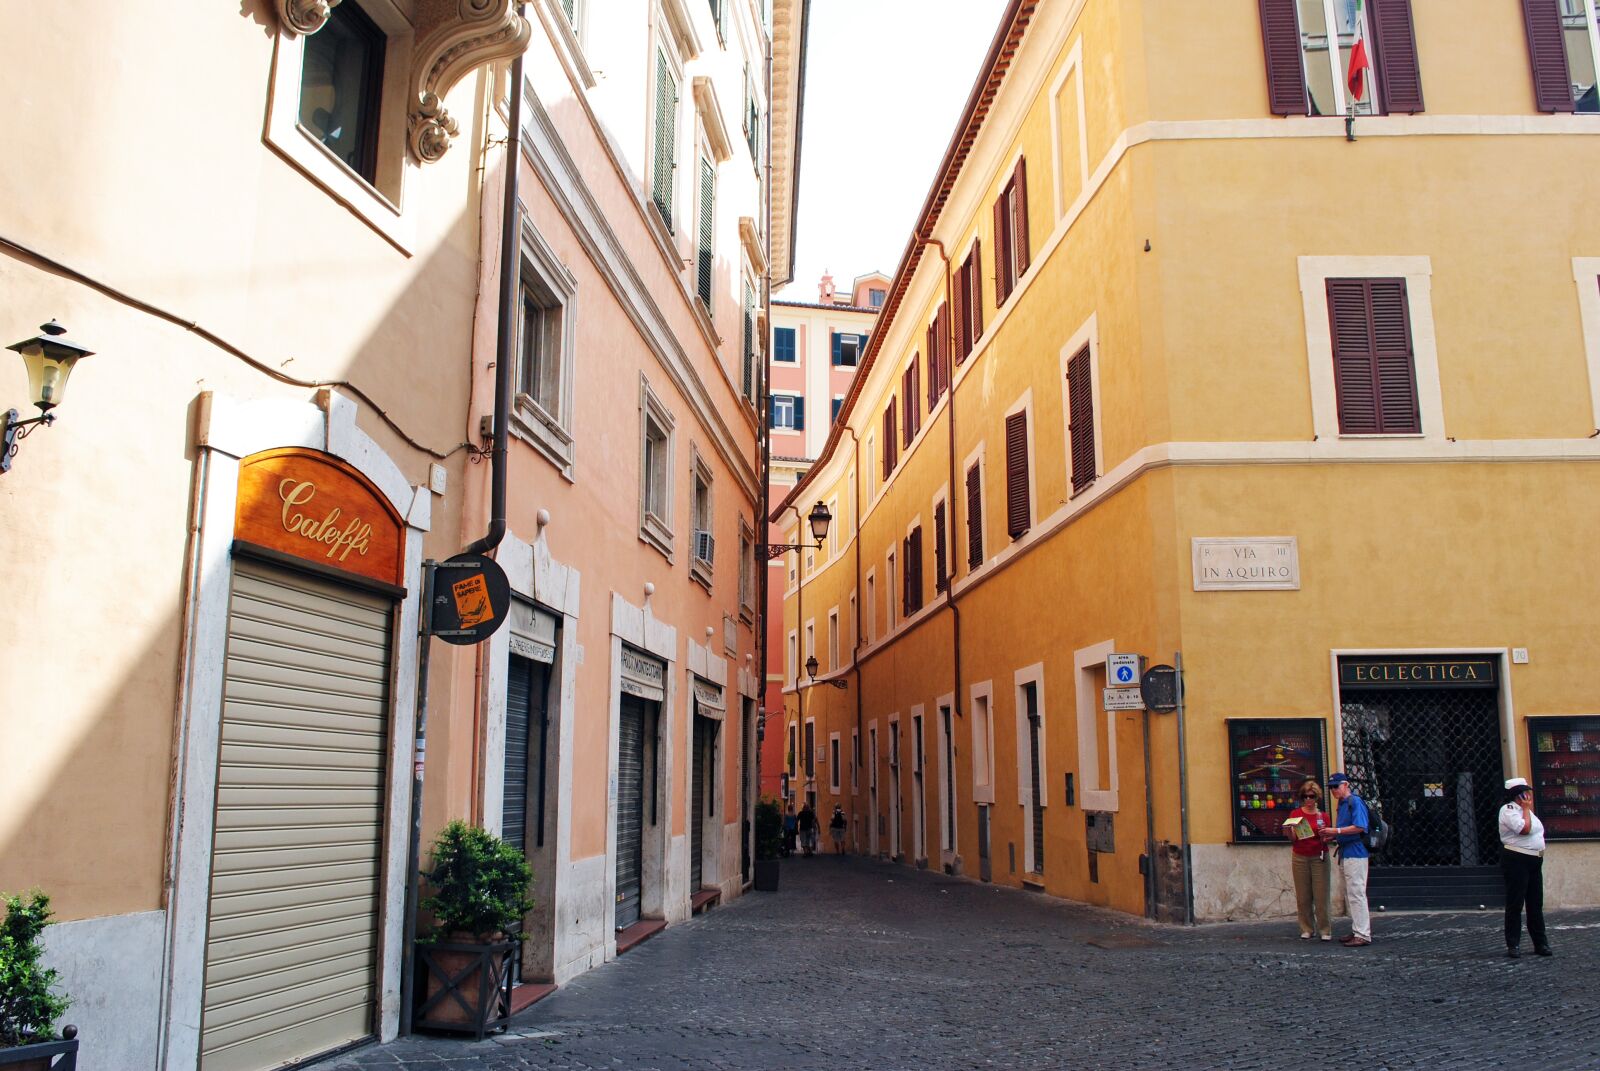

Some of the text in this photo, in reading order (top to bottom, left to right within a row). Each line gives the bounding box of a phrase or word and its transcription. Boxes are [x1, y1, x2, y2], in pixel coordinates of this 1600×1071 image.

[279, 478, 373, 561] Caleffi
[1233, 548, 1256, 559] VIA
[1277, 548, 1286, 556] III
[1204, 566, 1290, 579] IN AQUIRO
[1514, 651, 1526, 661] 70
[1356, 665, 1477, 680] ECLECTICA
